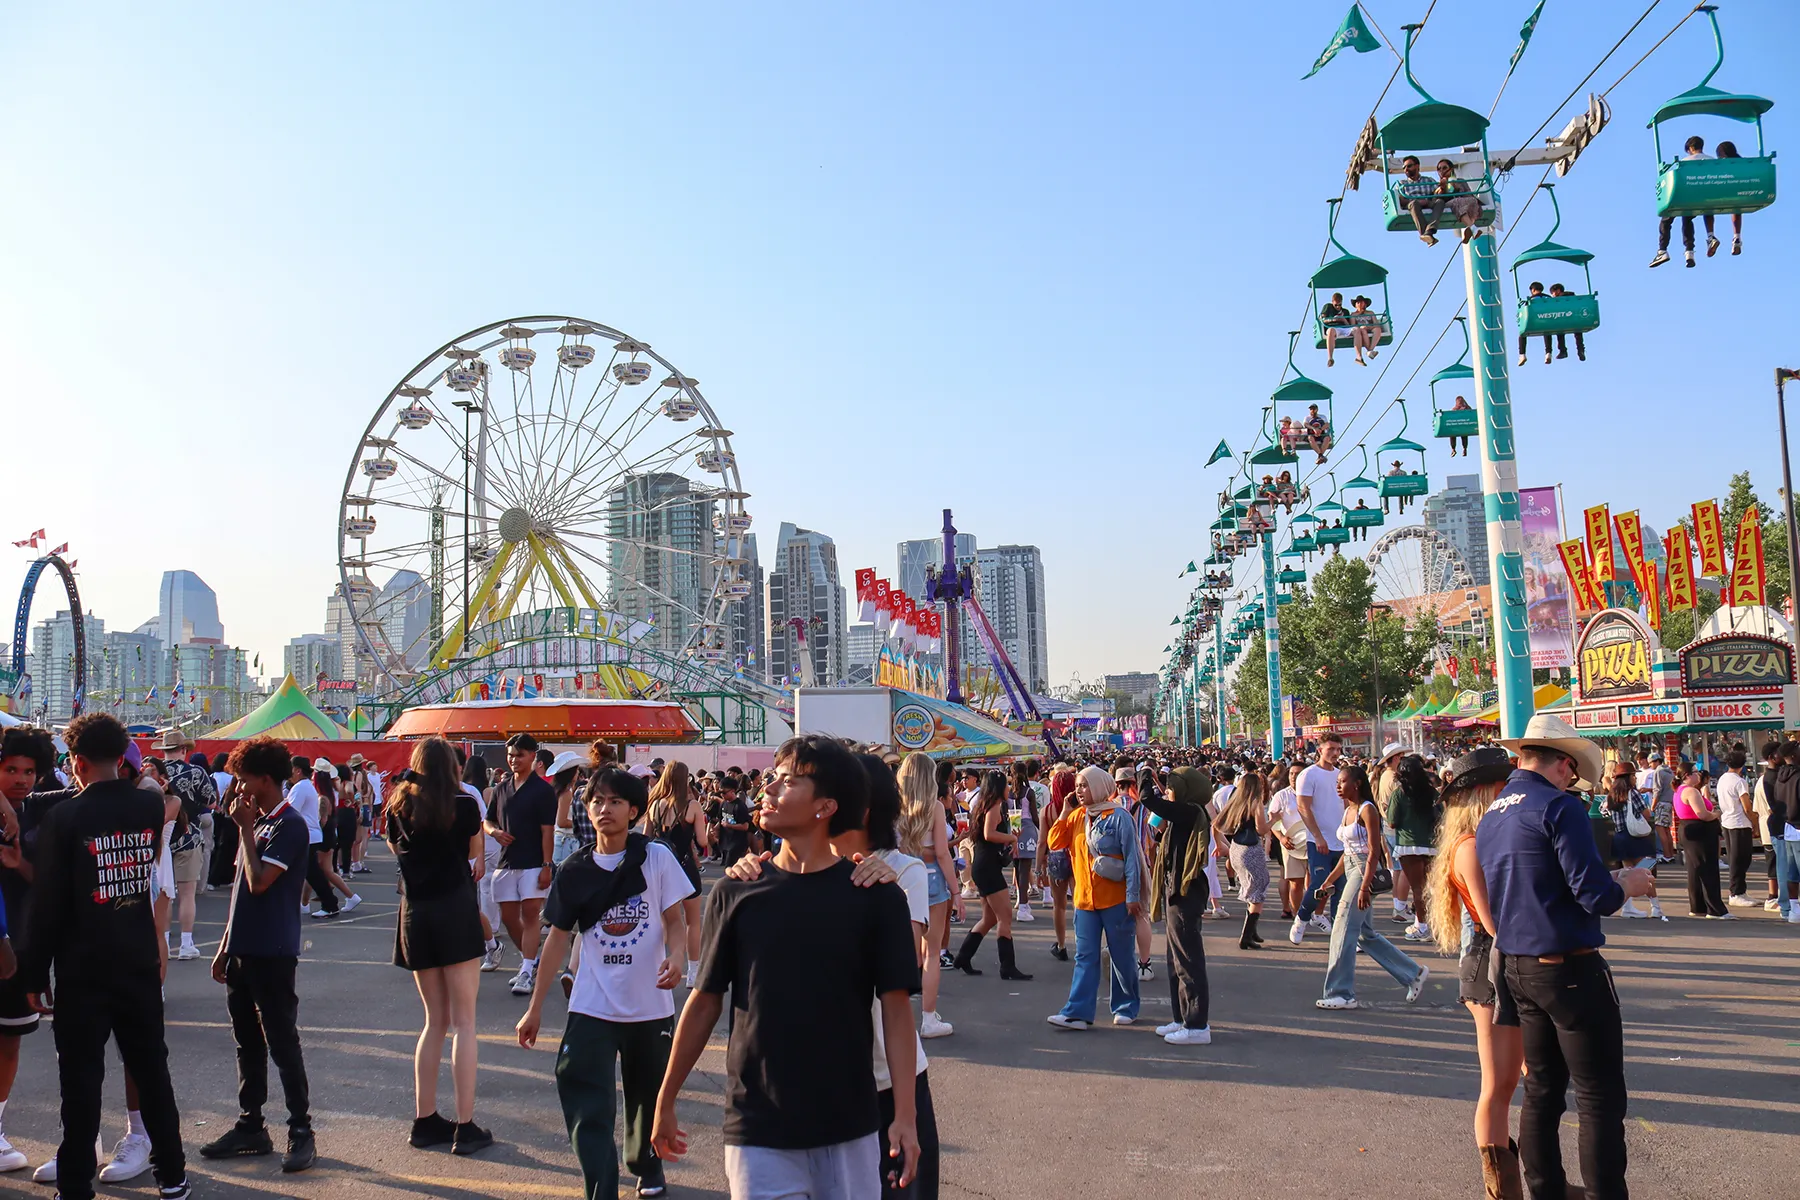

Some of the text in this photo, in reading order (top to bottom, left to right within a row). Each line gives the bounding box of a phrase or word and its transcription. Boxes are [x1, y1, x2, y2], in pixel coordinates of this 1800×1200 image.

[1537, 311, 1566, 320] WESTJET
[1591, 511, 1611, 577] PIZZA
[1699, 506, 1720, 573] PIZZA
[1671, 532, 1690, 606] PIZZA
[1737, 528, 1758, 602] PIZZA
[1583, 640, 1650, 693] PIZZA
[1690, 653, 1785, 681] PIZZA
[318, 680, 355, 691] OUTLAW
[902, 712, 924, 721] FRESH
[1627, 704, 1679, 716] ICE COLD
[1631, 713, 1675, 724] DRINKS
[1697, 703, 1753, 718] WHOLE
[905, 733, 922, 741] NOW
[95, 833, 152, 851] HOLLISTER
[98, 863, 151, 884] HOLLISTE
[99, 878, 150, 899] HOLLISTE
[601, 902, 649, 920] ENESIS
[603, 954, 633, 965] 2023
